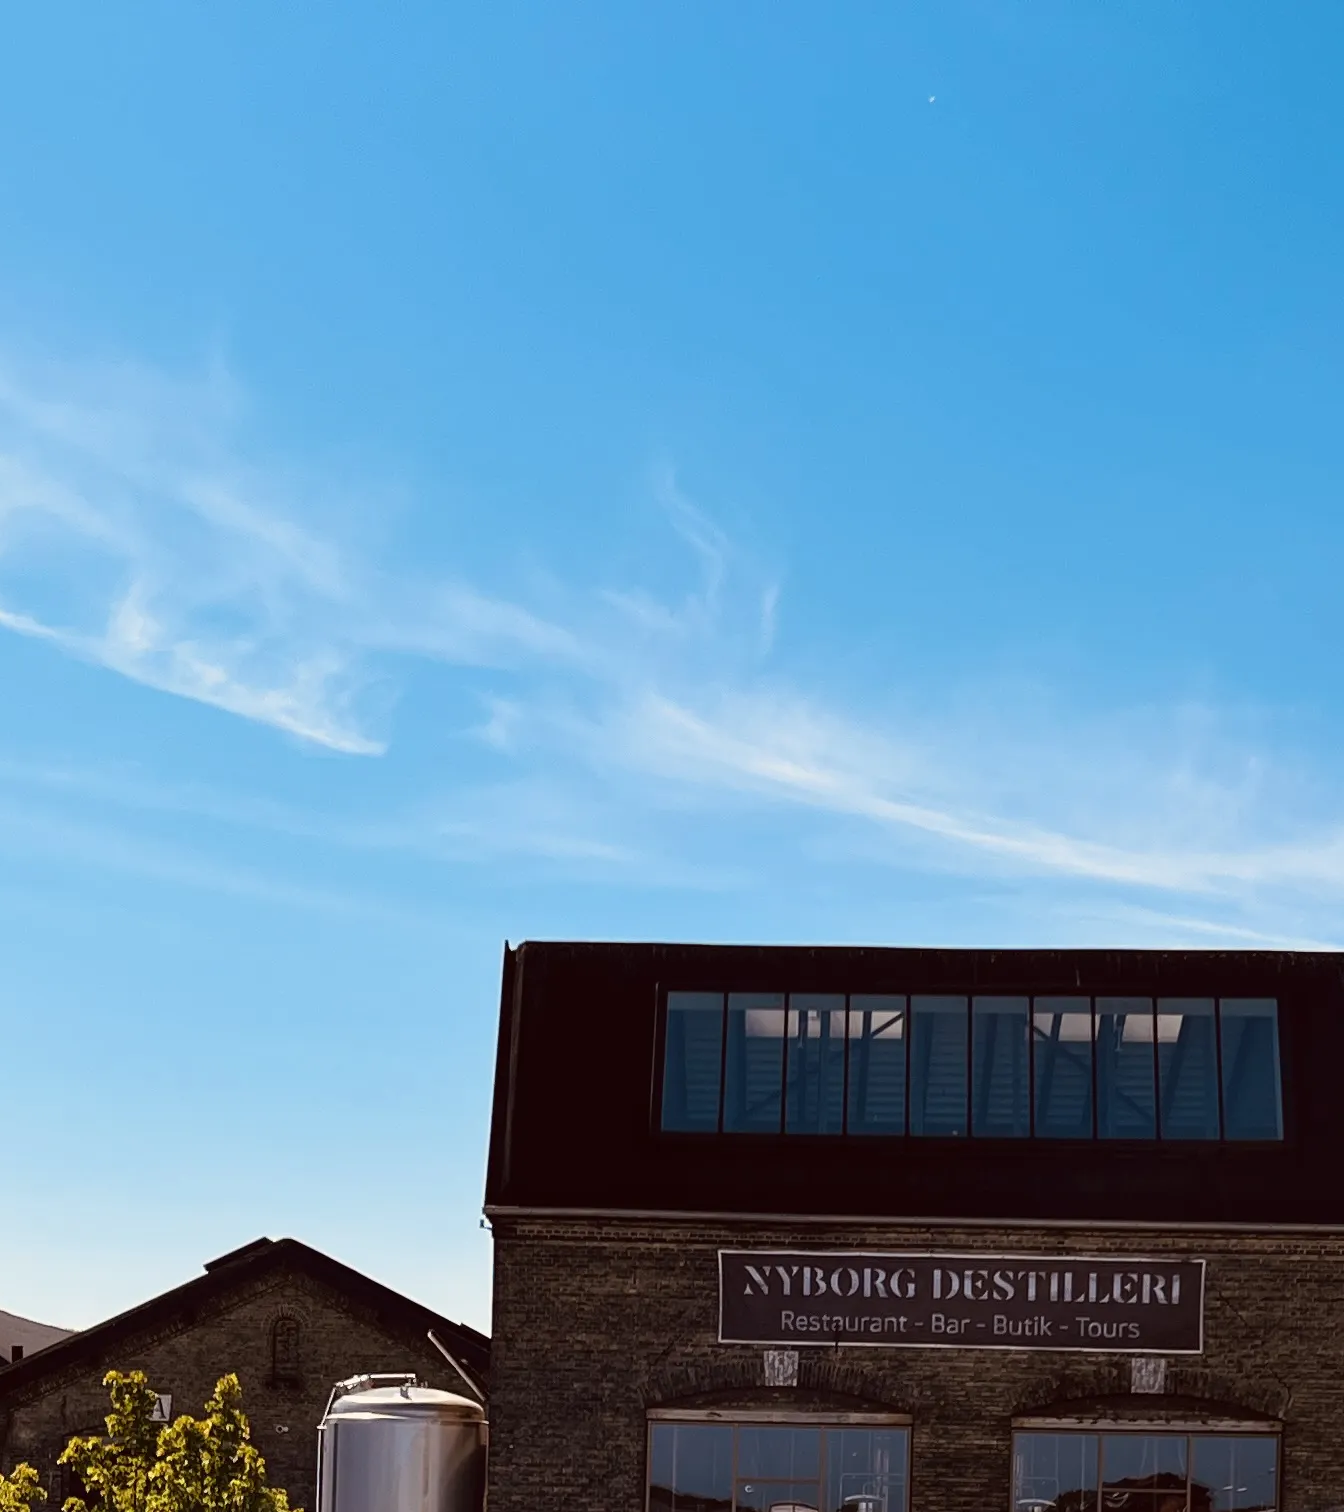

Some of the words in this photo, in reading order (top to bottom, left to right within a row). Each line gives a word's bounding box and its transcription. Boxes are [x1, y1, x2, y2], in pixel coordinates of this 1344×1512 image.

[743, 1265, 916, 1298] NYBORG
[932, 1268, 1181, 1304] DESTILLERI
[781, 1310, 908, 1333] Restaurant
[931, 1312, 971, 1334] Bar
[993, 1314, 1053, 1337] Butik
[1075, 1316, 1140, 1339] Tours
